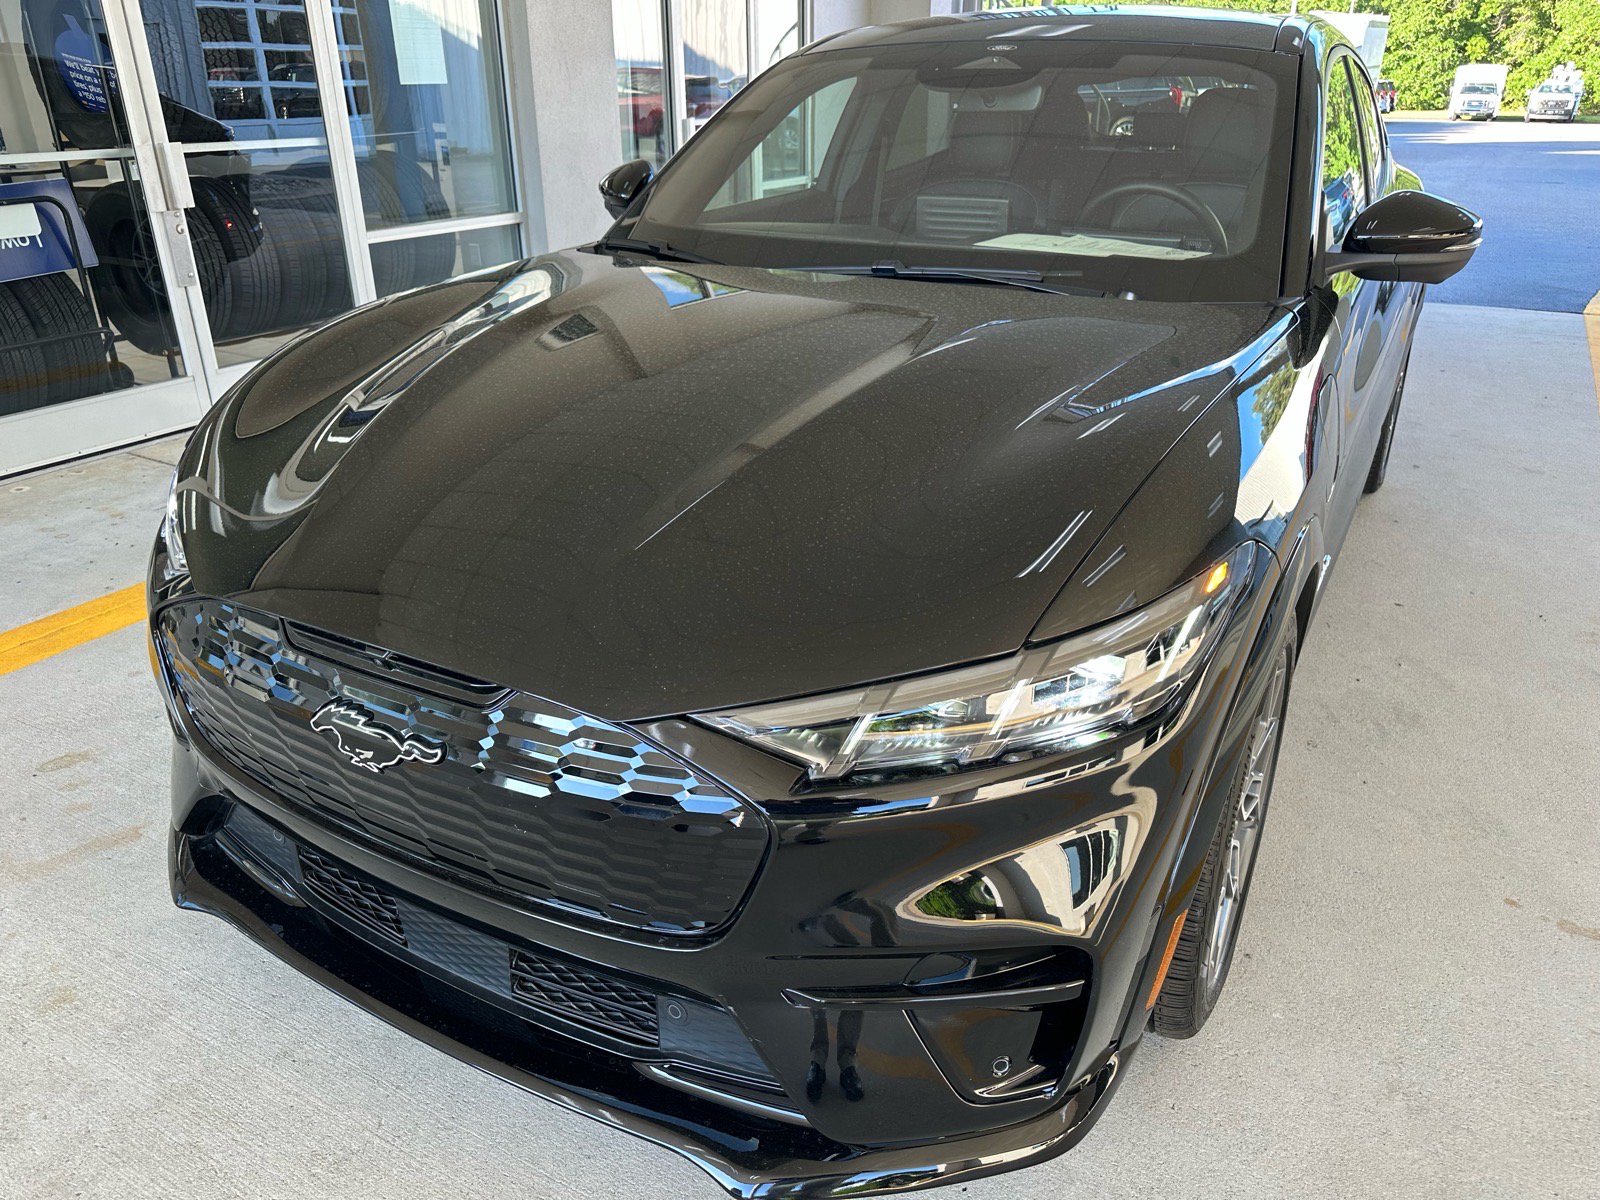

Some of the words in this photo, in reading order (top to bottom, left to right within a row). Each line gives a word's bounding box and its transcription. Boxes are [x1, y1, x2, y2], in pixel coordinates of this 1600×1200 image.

[80, 63, 95, 74] beat
[69, 71, 84, 81] price
[84, 75, 93, 83] on
[88, 85, 103, 94] plus
